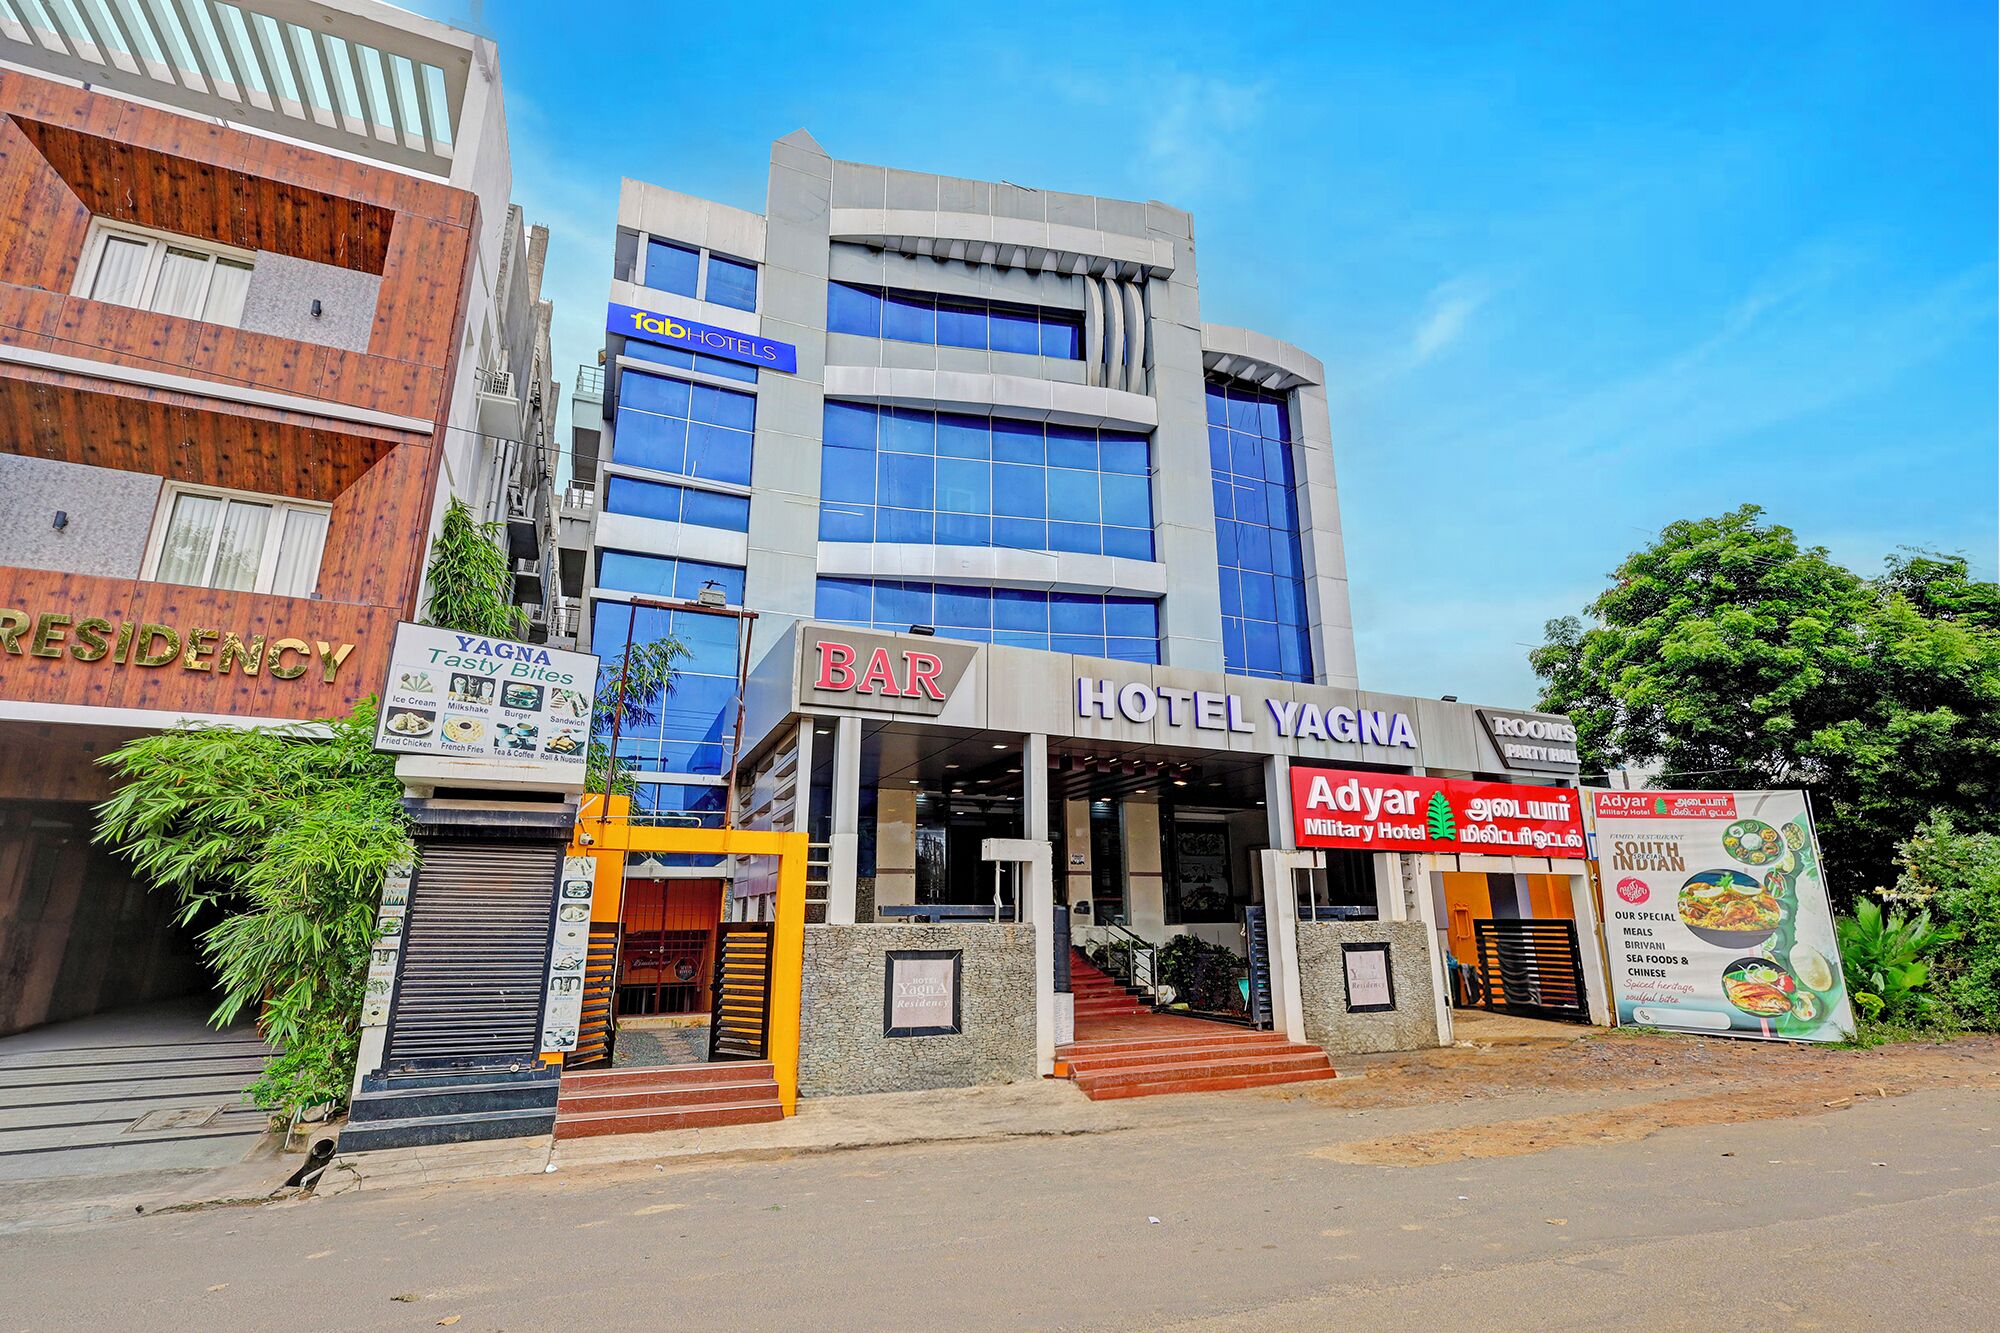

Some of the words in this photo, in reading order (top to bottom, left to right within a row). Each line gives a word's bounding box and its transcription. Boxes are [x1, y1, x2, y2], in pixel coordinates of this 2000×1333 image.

[631, 312, 777, 361] fabHOTELS
[0, 608, 356, 683] RESIDENCY
[456, 635, 551, 666] YAGNA
[428, 648, 503, 675] Tasty
[510, 663, 574, 685] Bites
[814, 641, 946, 701] BAR
[392, 695, 405, 704] Ice
[407, 697, 437, 707] Cream
[447, 702, 489, 714] Milkshake
[1078, 677, 1256, 734] HOTEL
[1266, 698, 1418, 748] YAGNA
[504, 709, 531, 720] Burger
[550, 715, 586, 726] Sandwich
[1493, 716, 1578, 742] ROOMS
[381, 736, 399, 746] Fried
[400, 737, 432, 748] Chicken
[440, 742, 465, 752] French
[467, 744, 484, 754] Fries
[493, 747, 505, 756] Tea
[505, 749, 512, 757] &
[513, 749, 535, 759] Coffee
[540, 752, 553, 761] Roll
[554, 754, 559, 762] &
[560, 755, 585, 764] Nuggets
[1504, 743, 1548, 760] PARTY
[1548, 747, 1582, 763] HALL
[1306, 775, 1420, 821] Adyar
[1600, 794, 1648, 810] Adyar
[1674, 796, 1728, 807] அடையார்
[1465, 794, 1571, 822] அடையார்
[1600, 808, 1628, 816] Military
[1304, 818, 1375, 843] Military
[1378, 821, 1426, 841] Hotel
[1614, 841, 1680, 857] SOUTH
[1633, 852, 1663, 860] SPECIAL
[1613, 855, 1686, 872] INDIAN
[1615, 911, 1636, 920] OUR
[1638, 912, 1677, 921] SPECIAL
[1623, 927, 1653, 936] MEALS
[1625, 941, 1666, 950] BIRIYANI
[1626, 954, 1644, 963] SEA
[1646, 955, 1679, 965] FOODS
[1681, 957, 1689, 965] &
[1628, 967, 1666, 978] CHINESE
[1624, 979, 1655, 990] Spiced
[1656, 980, 1695, 993] heritage,
[896, 1000, 949, 1008] Residency
[1626, 992, 1656, 1004] soulful
